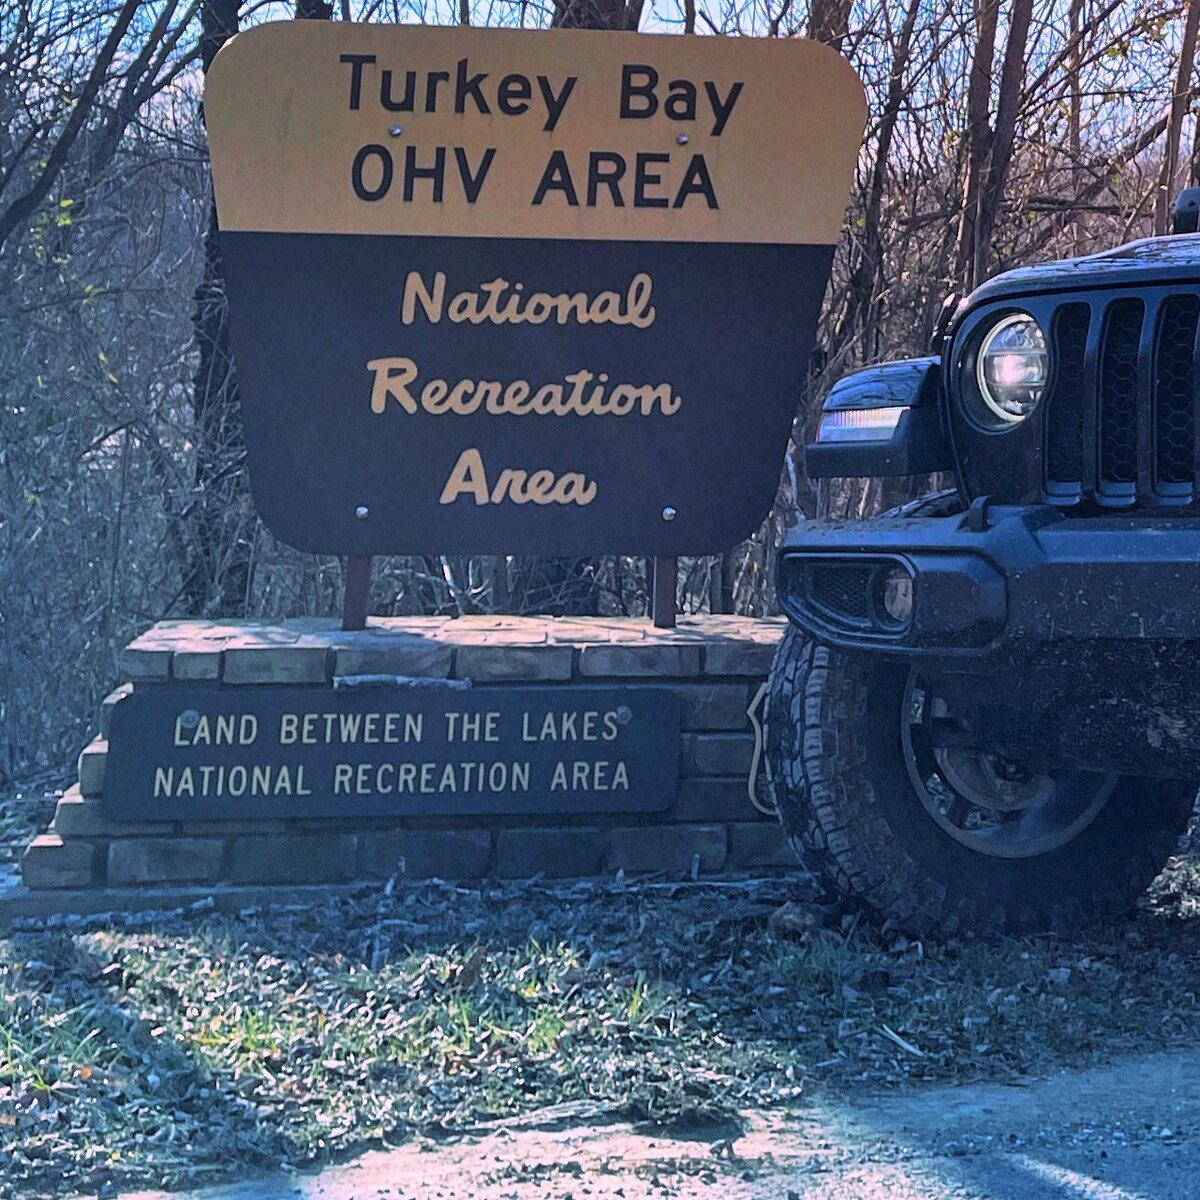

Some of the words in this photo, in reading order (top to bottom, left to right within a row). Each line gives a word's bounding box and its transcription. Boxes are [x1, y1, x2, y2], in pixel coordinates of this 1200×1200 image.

[340, 54, 578, 131] Turkey
[619, 64, 744, 136] Bay
[351, 144, 496, 203] OHV
[532, 150, 719, 210] AREA
[401, 272, 656, 328] National
[366, 357, 682, 417] Recreation
[440, 448, 597, 506] Area
[174, 714, 257, 746] LAND
[280, 712, 423, 745] BETWEEN
[445, 711, 500, 742] THE
[522, 711, 618, 742] LAKES
[154, 765, 312, 798] NATIONAL
[333, 762, 530, 795] RECREATION
[550, 761, 630, 792] AREA
